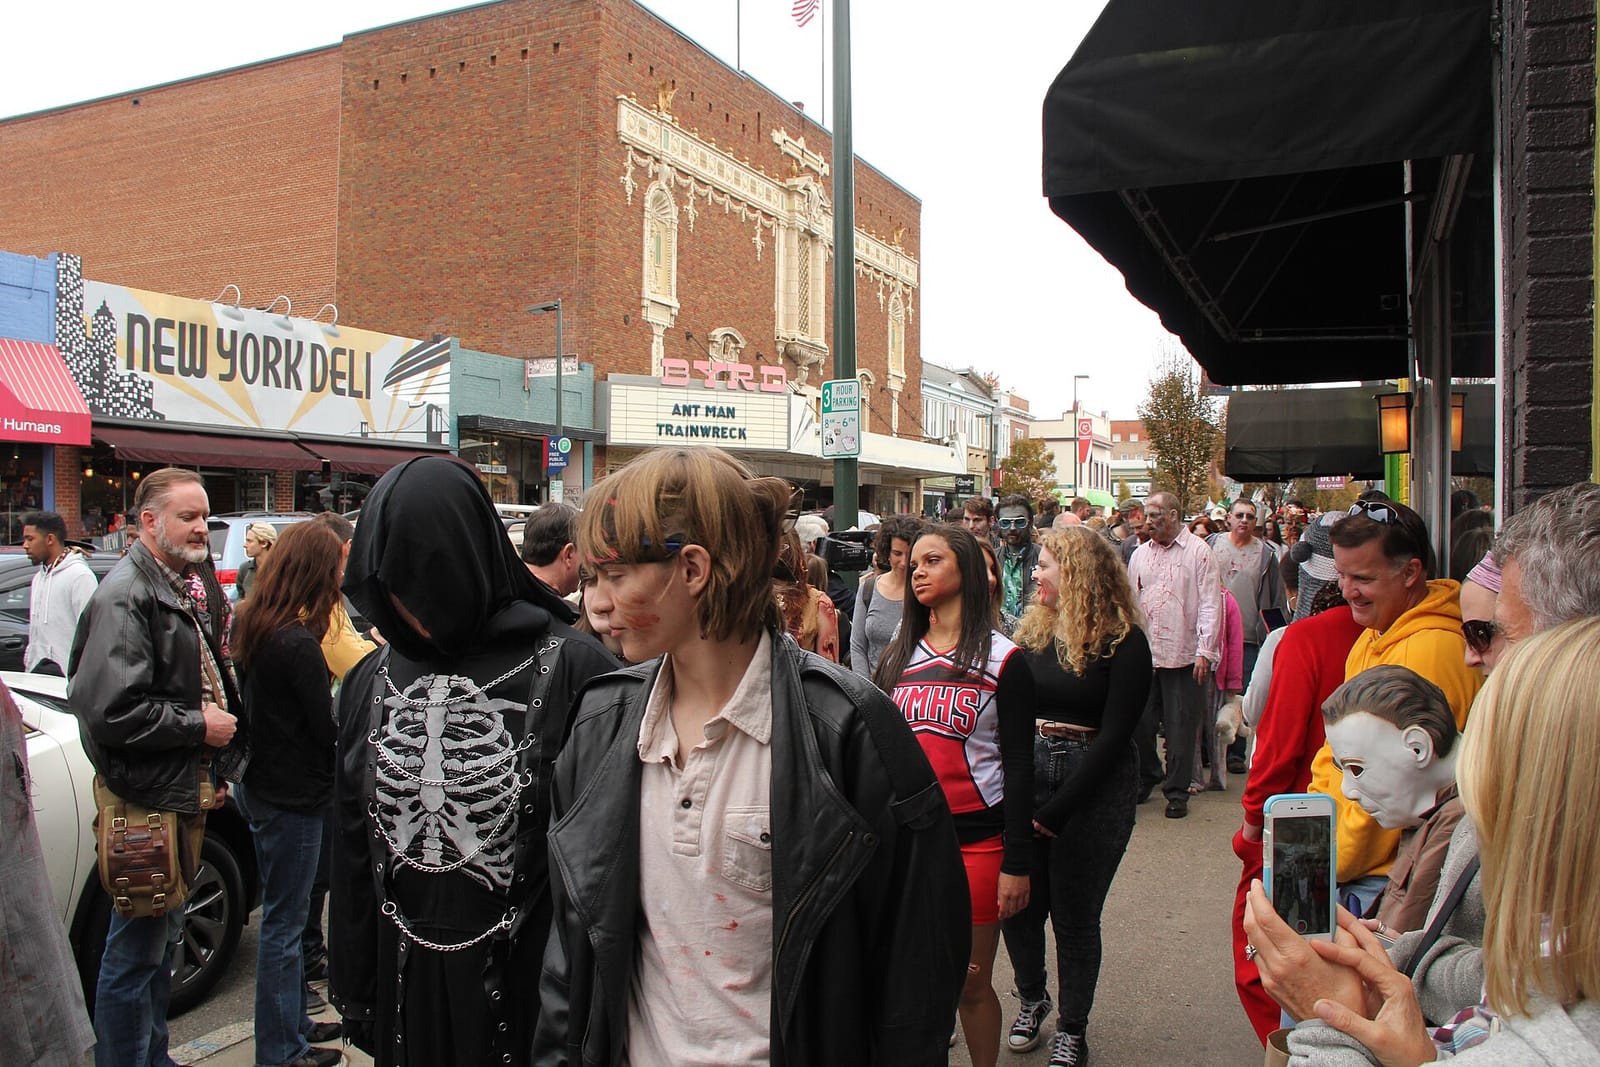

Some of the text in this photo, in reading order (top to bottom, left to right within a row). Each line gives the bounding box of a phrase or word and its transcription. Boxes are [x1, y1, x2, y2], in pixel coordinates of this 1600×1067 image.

[126, 312, 371, 400] NEW YORK DELI
[661, 358, 787, 393] BYRD
[823, 388, 831, 408] 3
[832, 396, 857, 408] PARKING
[672, 403, 736, 419] ANT MAN
[4, 417, 62, 434] Humans
[656, 423, 747, 440] TRAINWRECK
